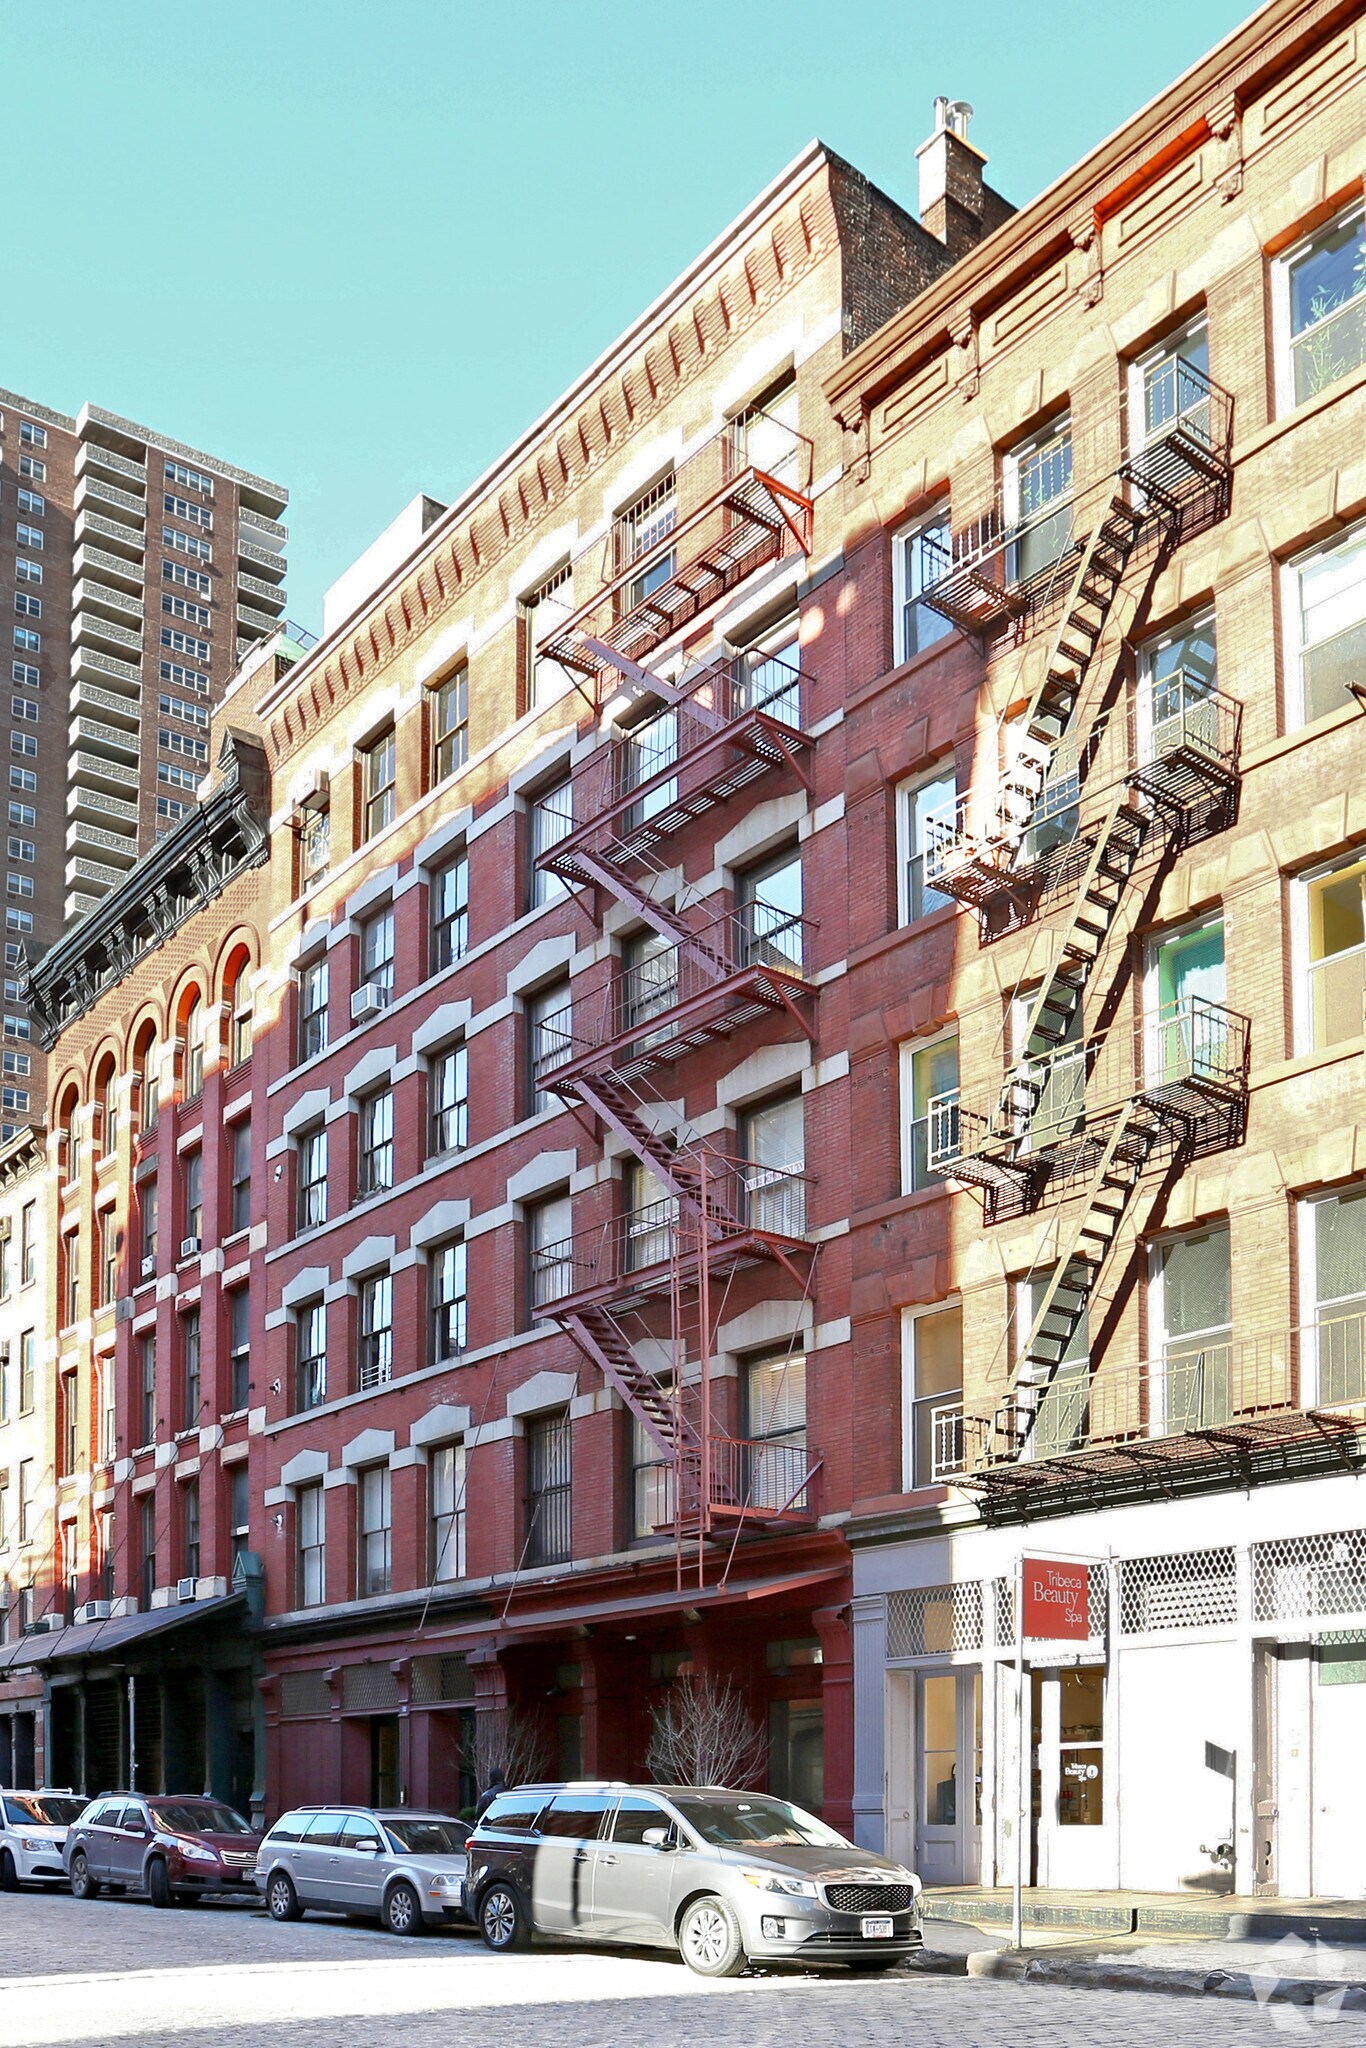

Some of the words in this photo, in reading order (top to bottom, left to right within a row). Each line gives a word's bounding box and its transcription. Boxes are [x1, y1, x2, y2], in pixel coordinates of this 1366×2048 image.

[1046, 1570, 1082, 1589] Tribeca
[1033, 1581, 1079, 1612] Beauty
[1065, 1608, 1082, 1628] Spa
[1064, 1767, 1085, 1776] Beauty
